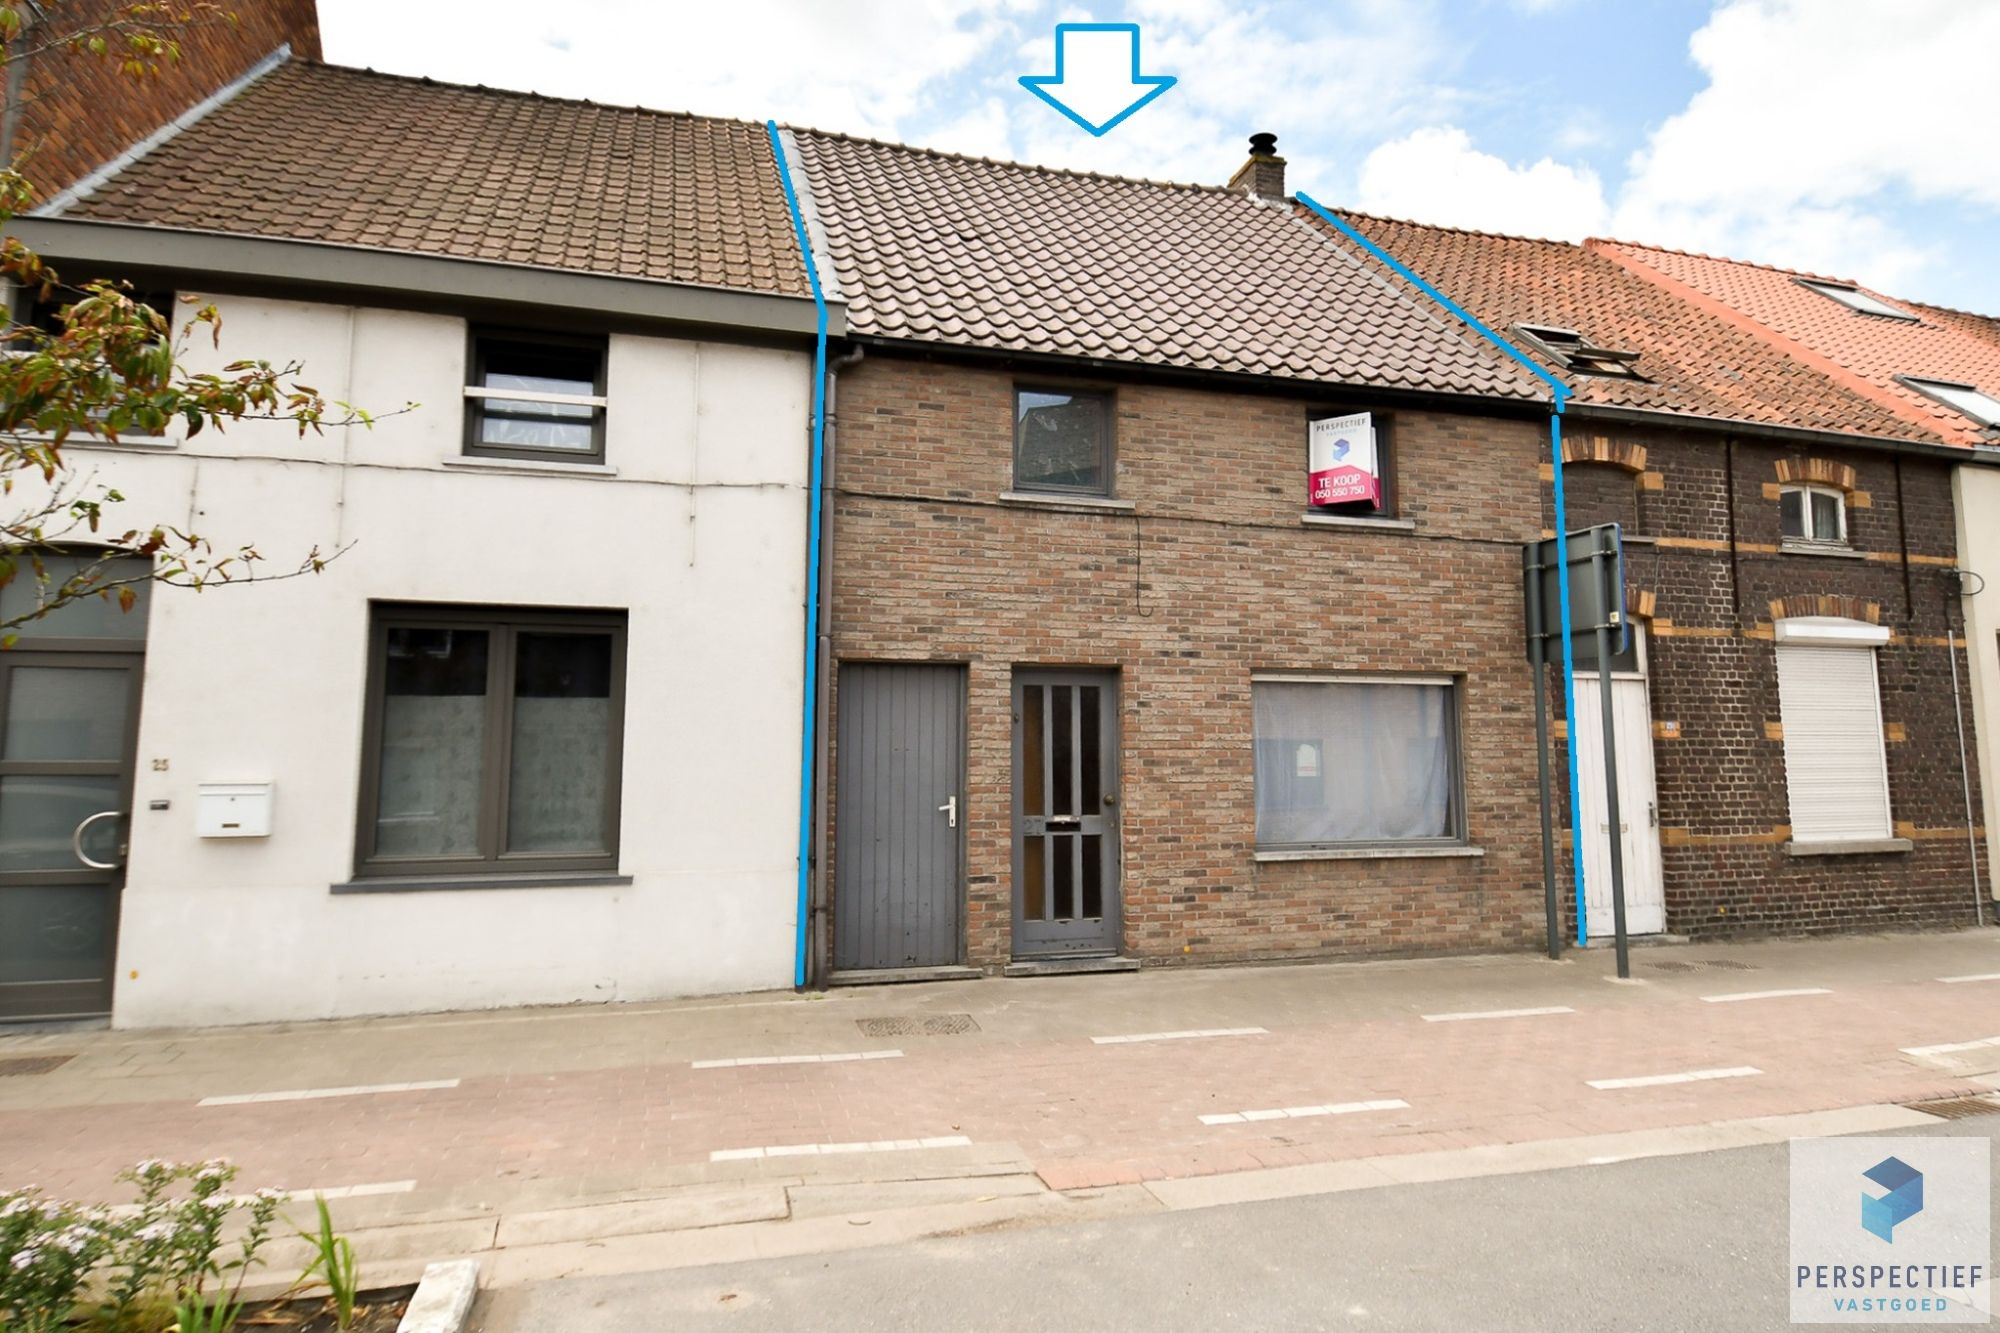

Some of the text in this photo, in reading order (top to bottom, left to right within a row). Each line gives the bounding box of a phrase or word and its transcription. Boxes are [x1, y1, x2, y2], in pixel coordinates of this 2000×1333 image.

[1316, 418, 1366, 432] PERSPECTIEF
[1318, 473, 1361, 488] TE KOOP
